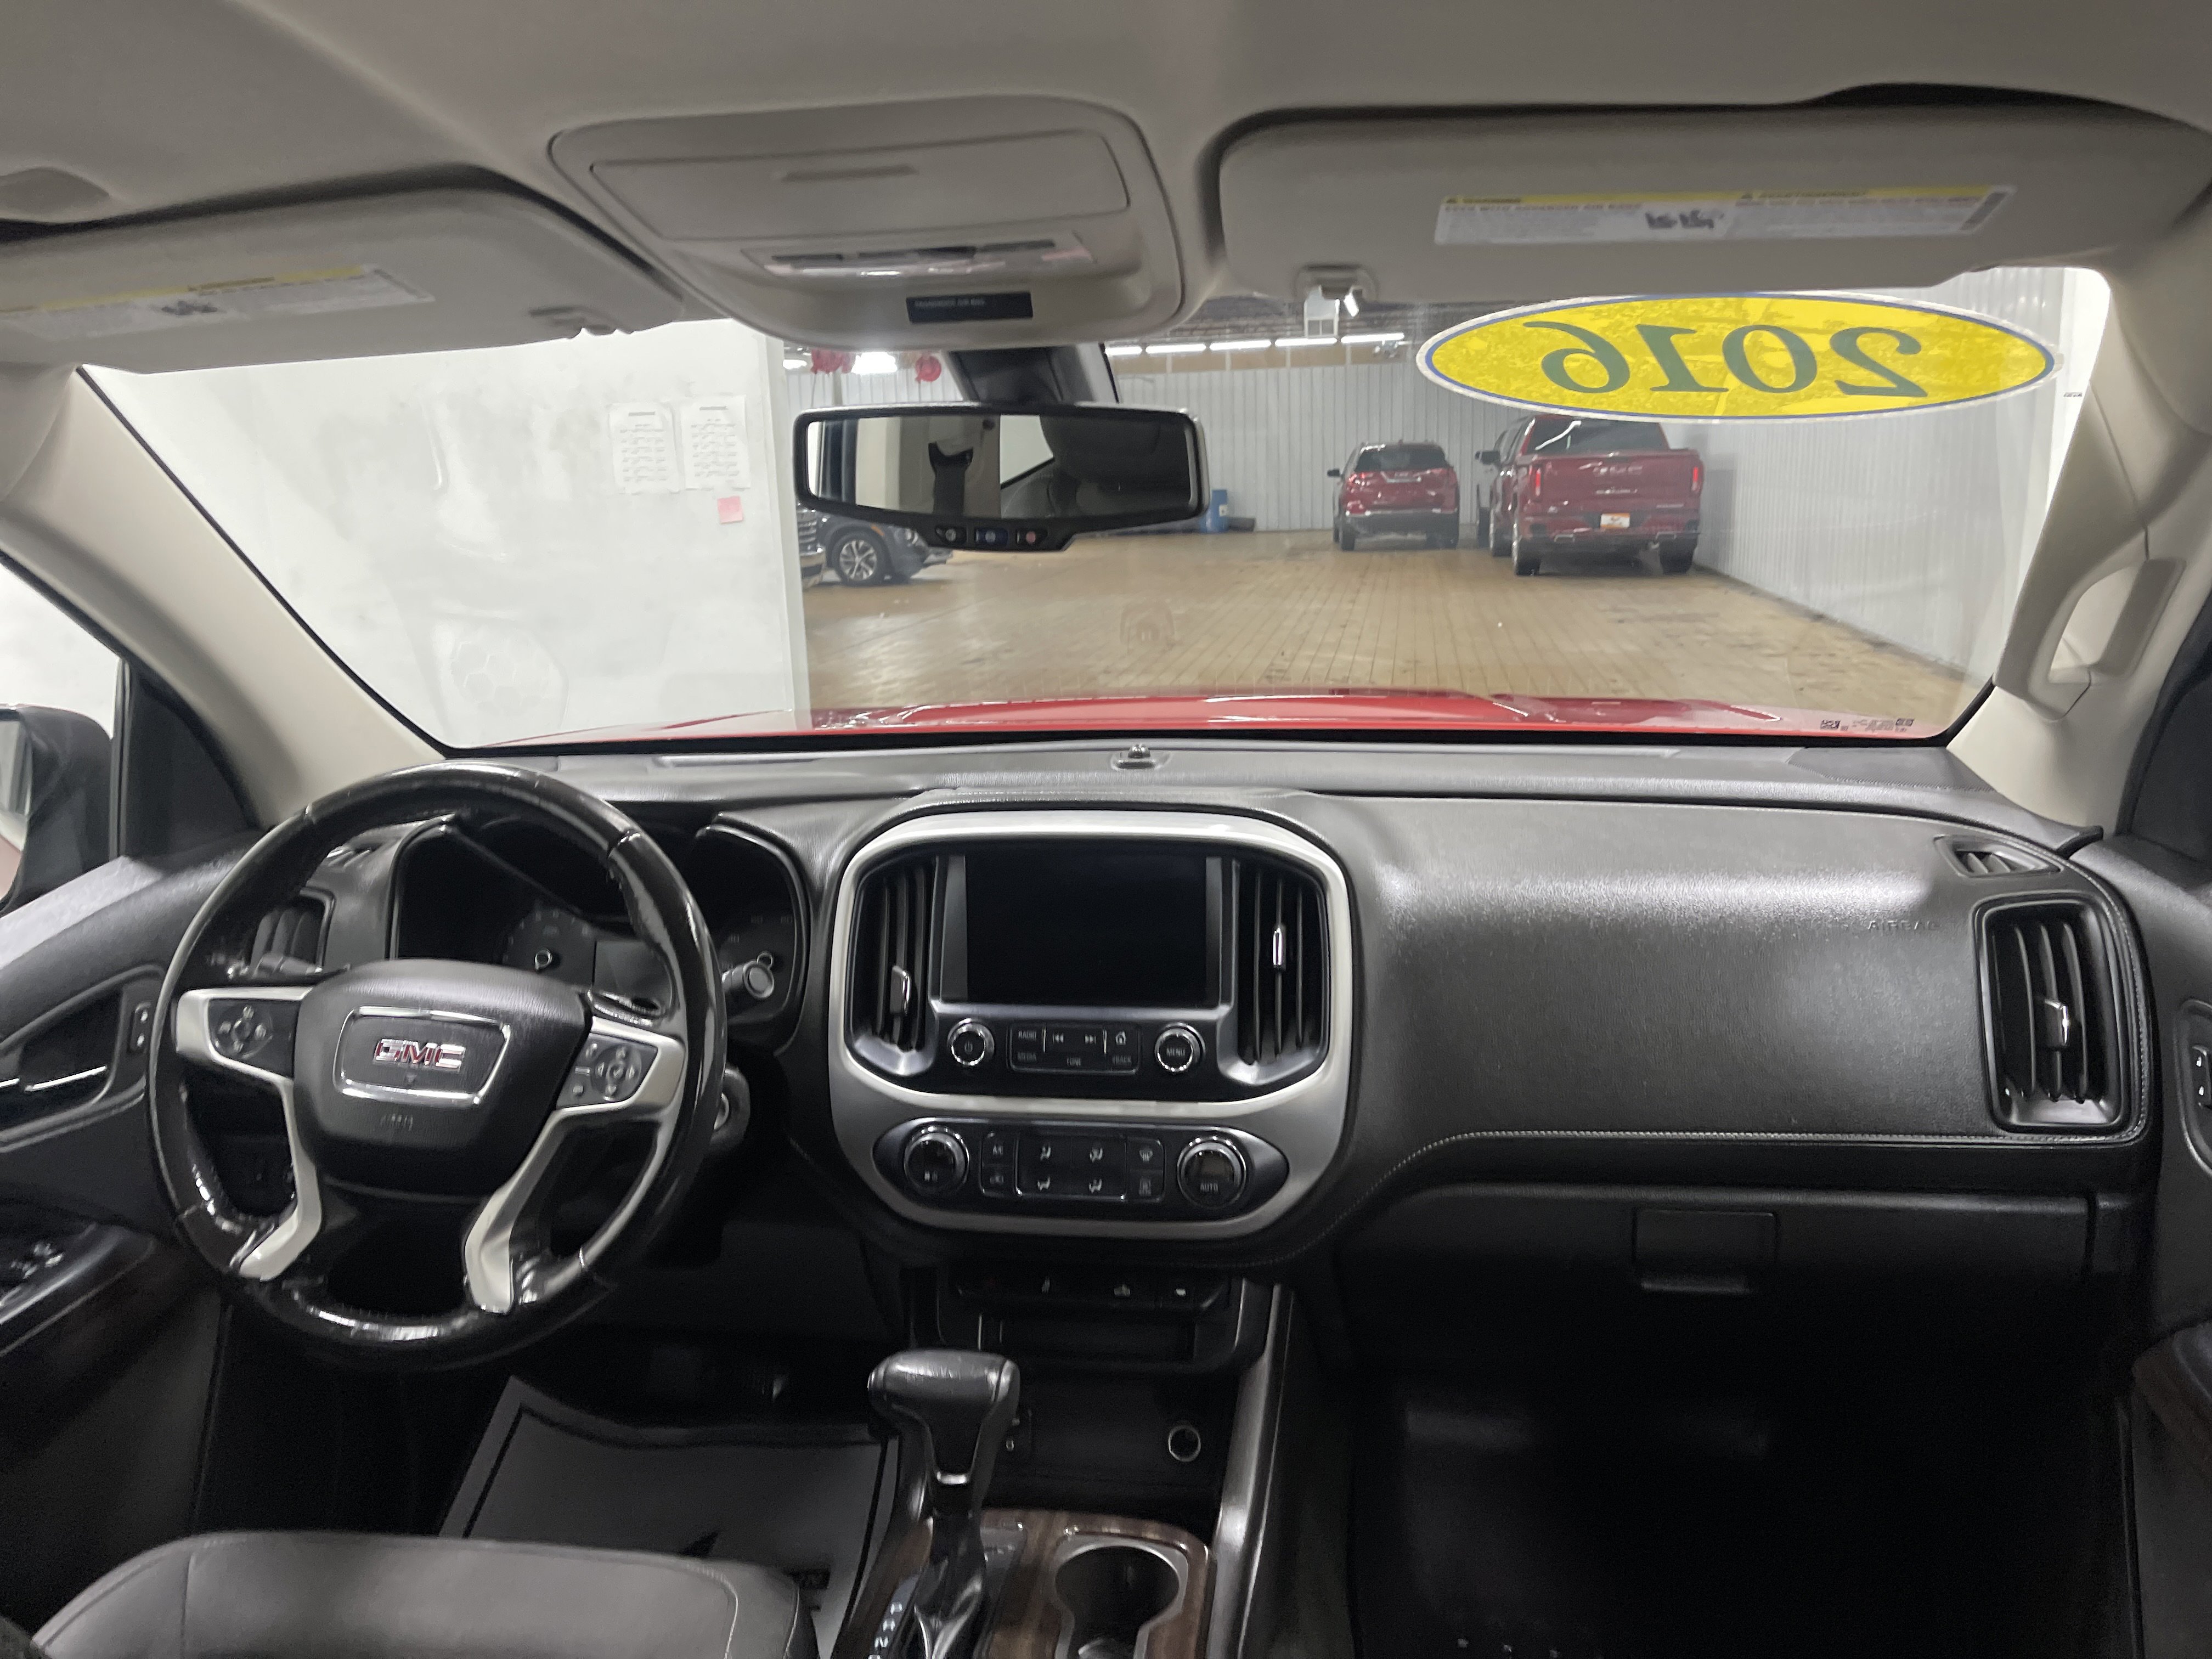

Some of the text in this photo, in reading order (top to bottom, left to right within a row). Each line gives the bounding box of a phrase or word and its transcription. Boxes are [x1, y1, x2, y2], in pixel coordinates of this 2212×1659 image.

[1018, 1030, 1037, 1040] RADIO
[374, 1038, 466, 1070] GMC
[1166, 1047, 1186, 1057] MENU
[1200, 1182, 1218, 1193] AUTO
[874, 1636, 889, 1648] N
